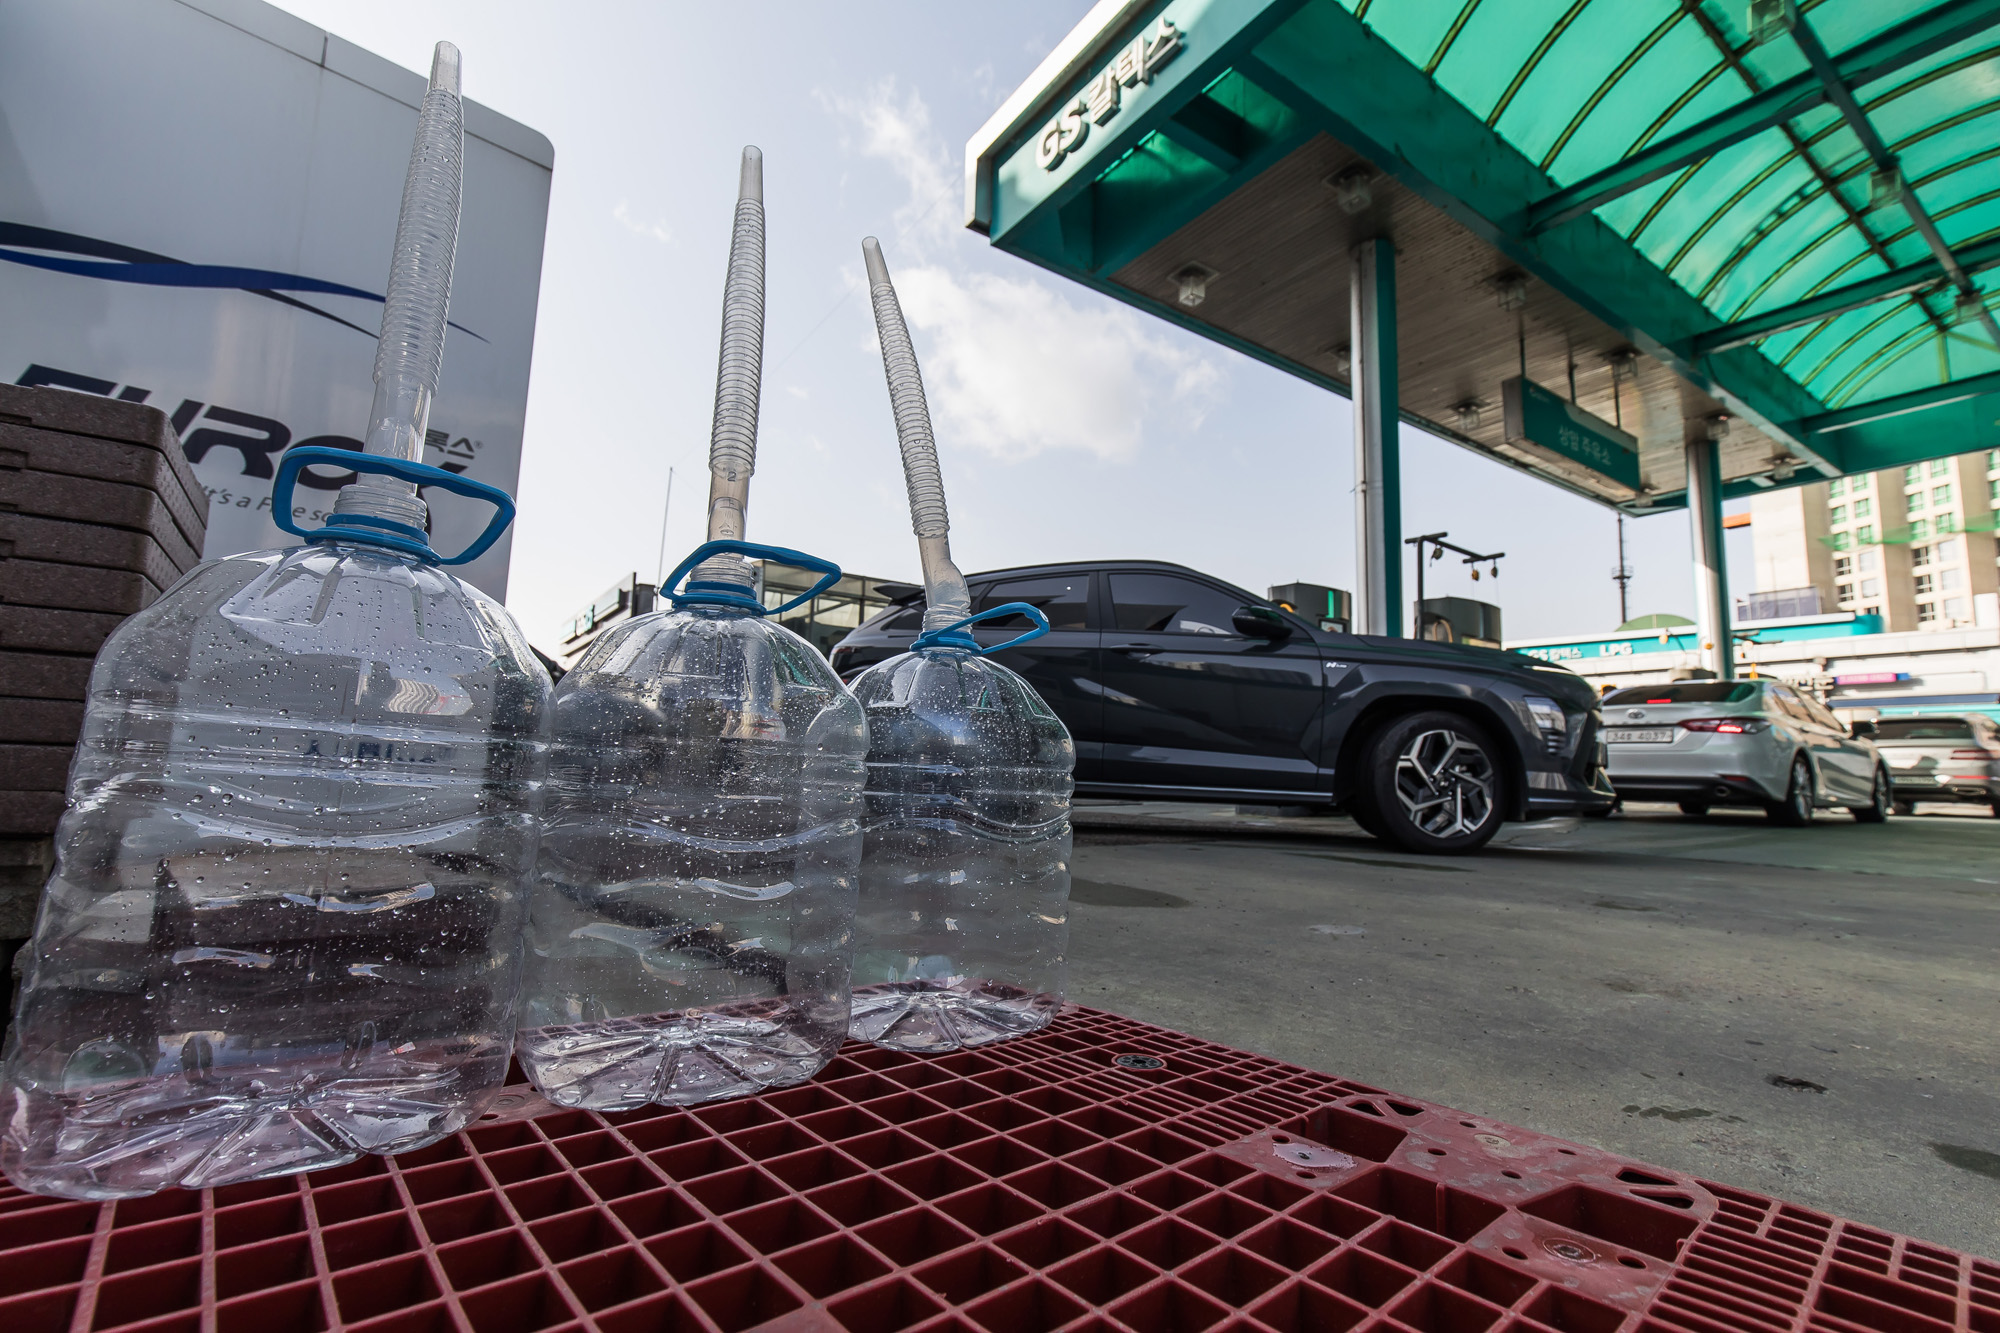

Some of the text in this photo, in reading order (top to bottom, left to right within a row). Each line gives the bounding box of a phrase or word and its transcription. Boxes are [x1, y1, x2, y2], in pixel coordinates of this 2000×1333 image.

[236, 496, 252, 508] a
[257, 497, 306, 518] Fe
[1598, 642, 1634, 657] LPG
